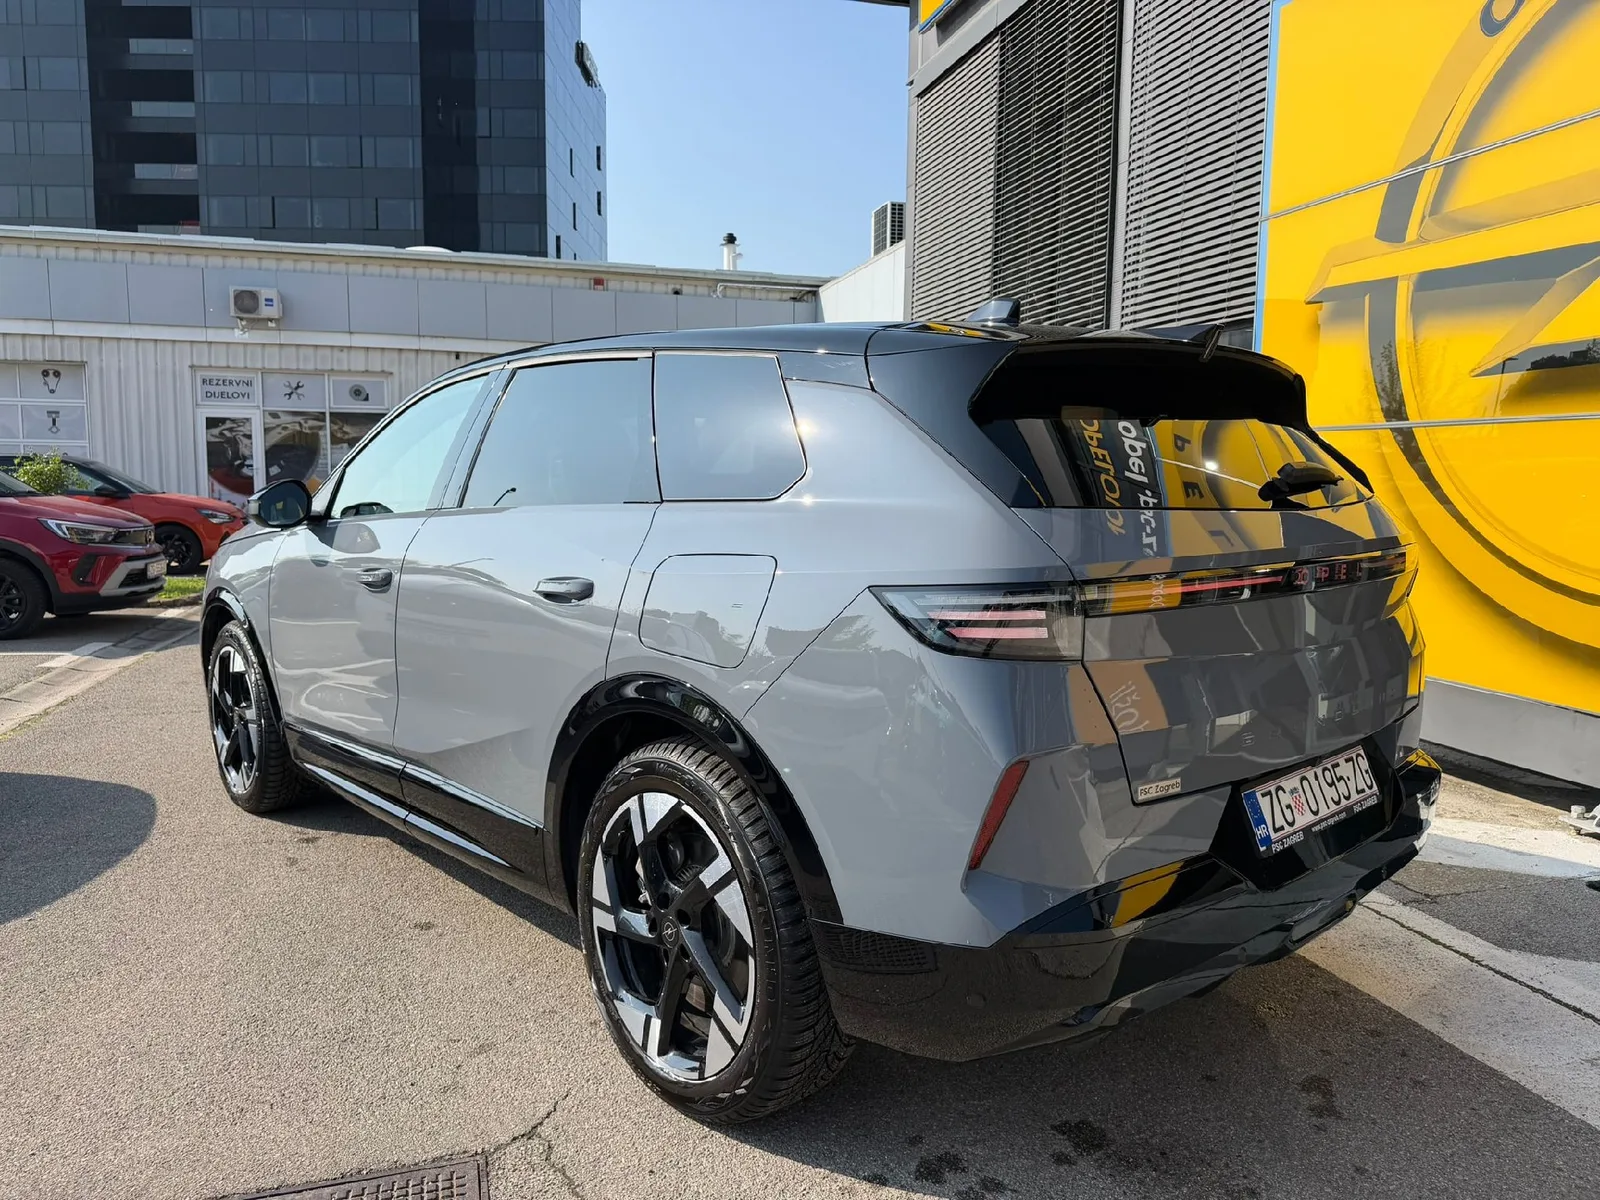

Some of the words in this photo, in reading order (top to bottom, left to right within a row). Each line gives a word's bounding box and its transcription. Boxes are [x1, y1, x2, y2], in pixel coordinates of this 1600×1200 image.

[202, 378, 253, 388] REZERVNI
[205, 390, 250, 400] DIJELOVI
[1155, 780, 1180, 793] Zagreb
[1261, 785, 1296, 833] ZG
[1256, 824, 1269, 840] HR
[1271, 840, 1284, 854] PSC
[1283, 831, 1304, 847] ZAGREB
